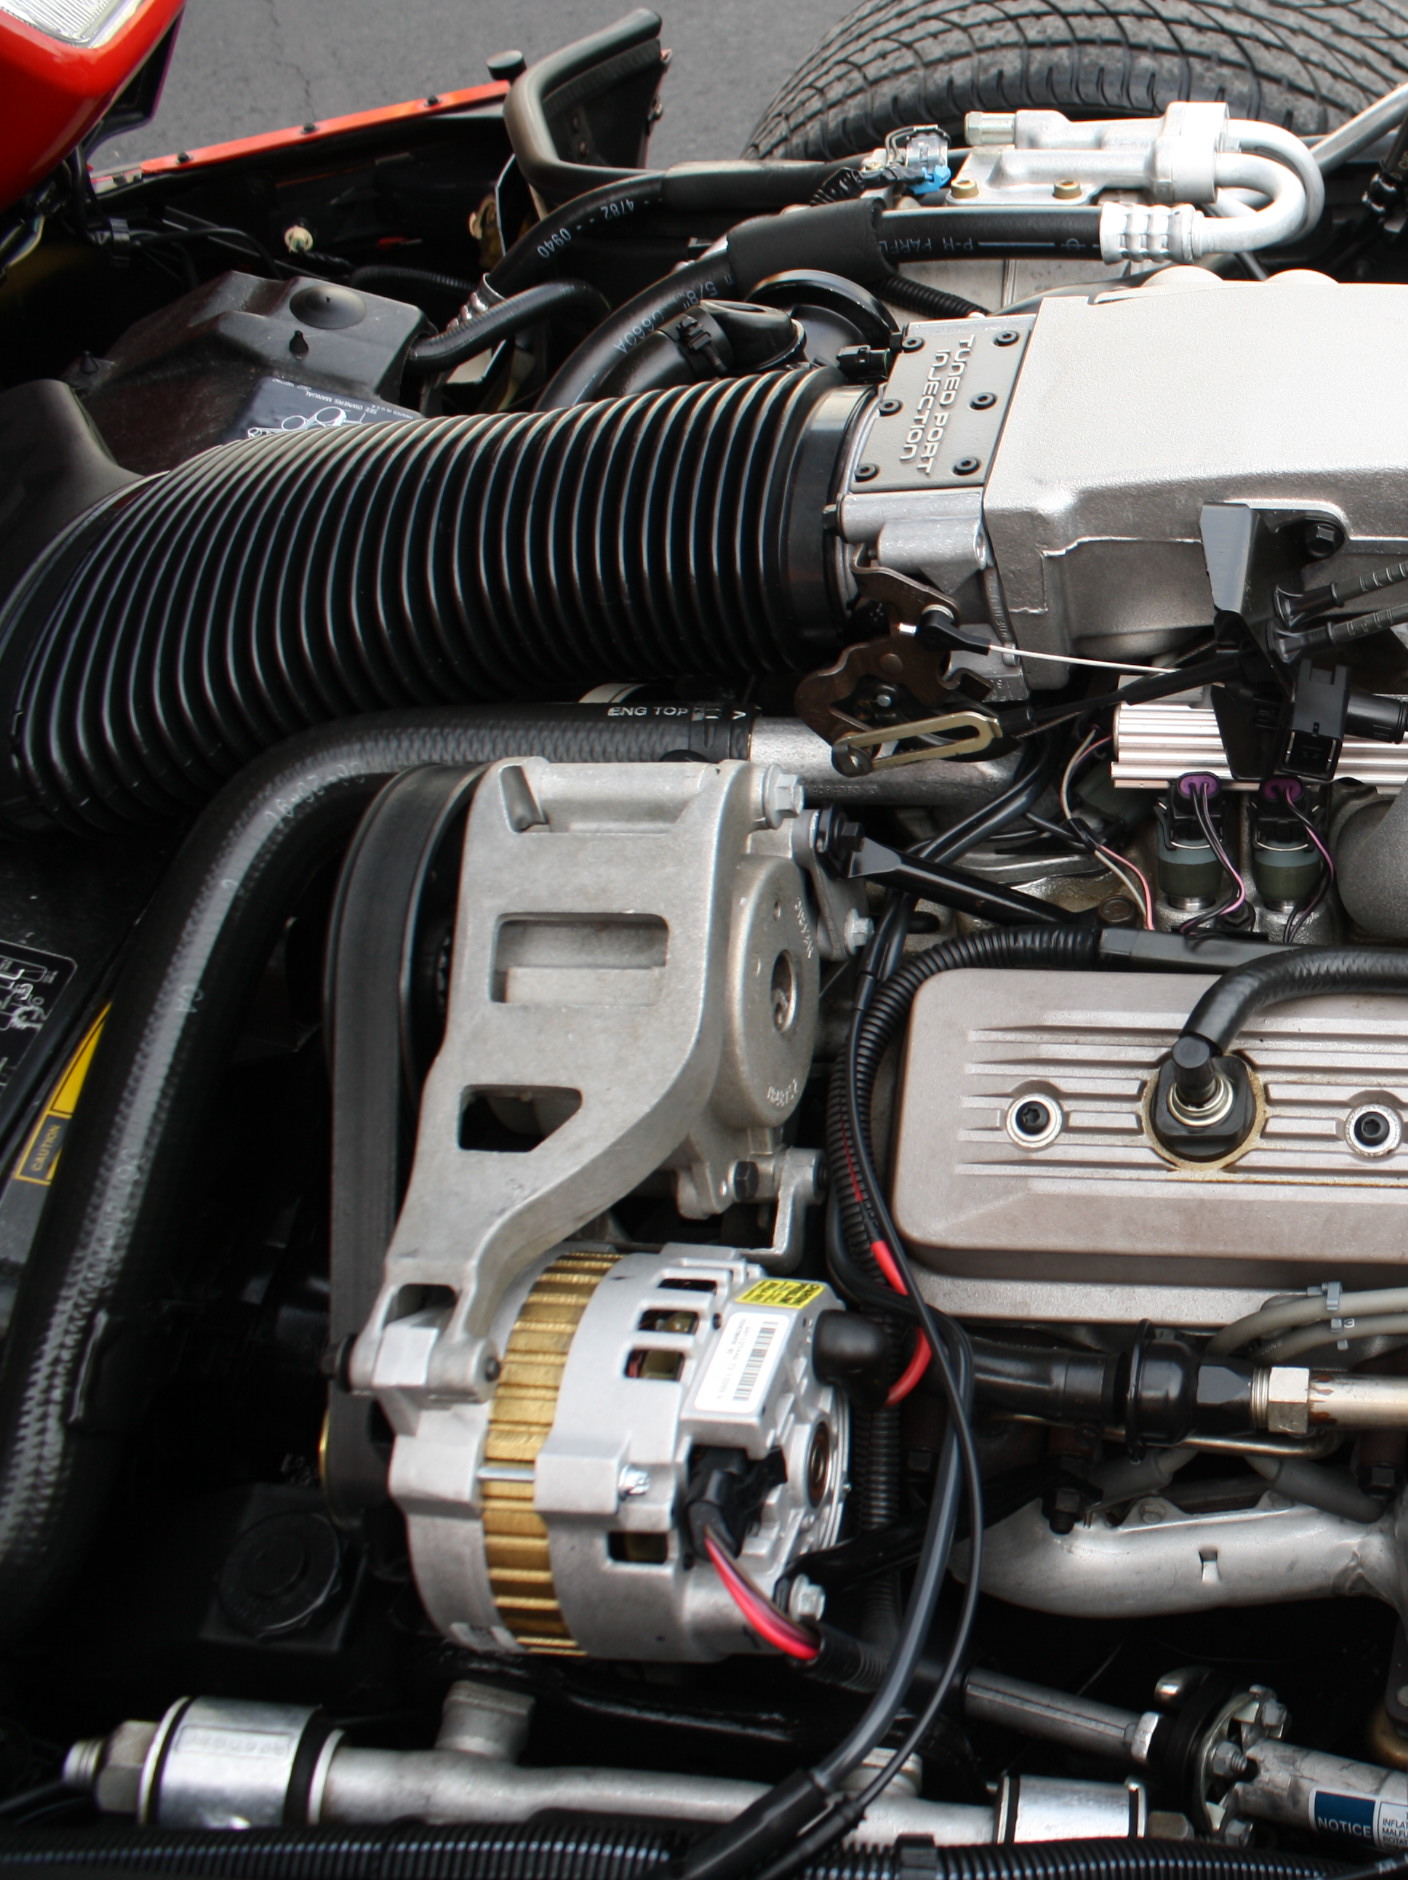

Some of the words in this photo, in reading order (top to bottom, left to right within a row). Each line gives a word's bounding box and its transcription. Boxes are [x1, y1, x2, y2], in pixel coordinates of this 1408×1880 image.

[537, 227, 572, 258] 0940
[939, 334, 976, 406] TUNED
[900, 349, 951, 460] INJECTION
[917, 412, 950, 475] PORT
[607, 705, 649, 718] ENG
[652, 705, 689, 718] TOP
[31, 1124, 61, 1172] CAUTION
[1318, 1815, 1373, 1839] NOTICE
